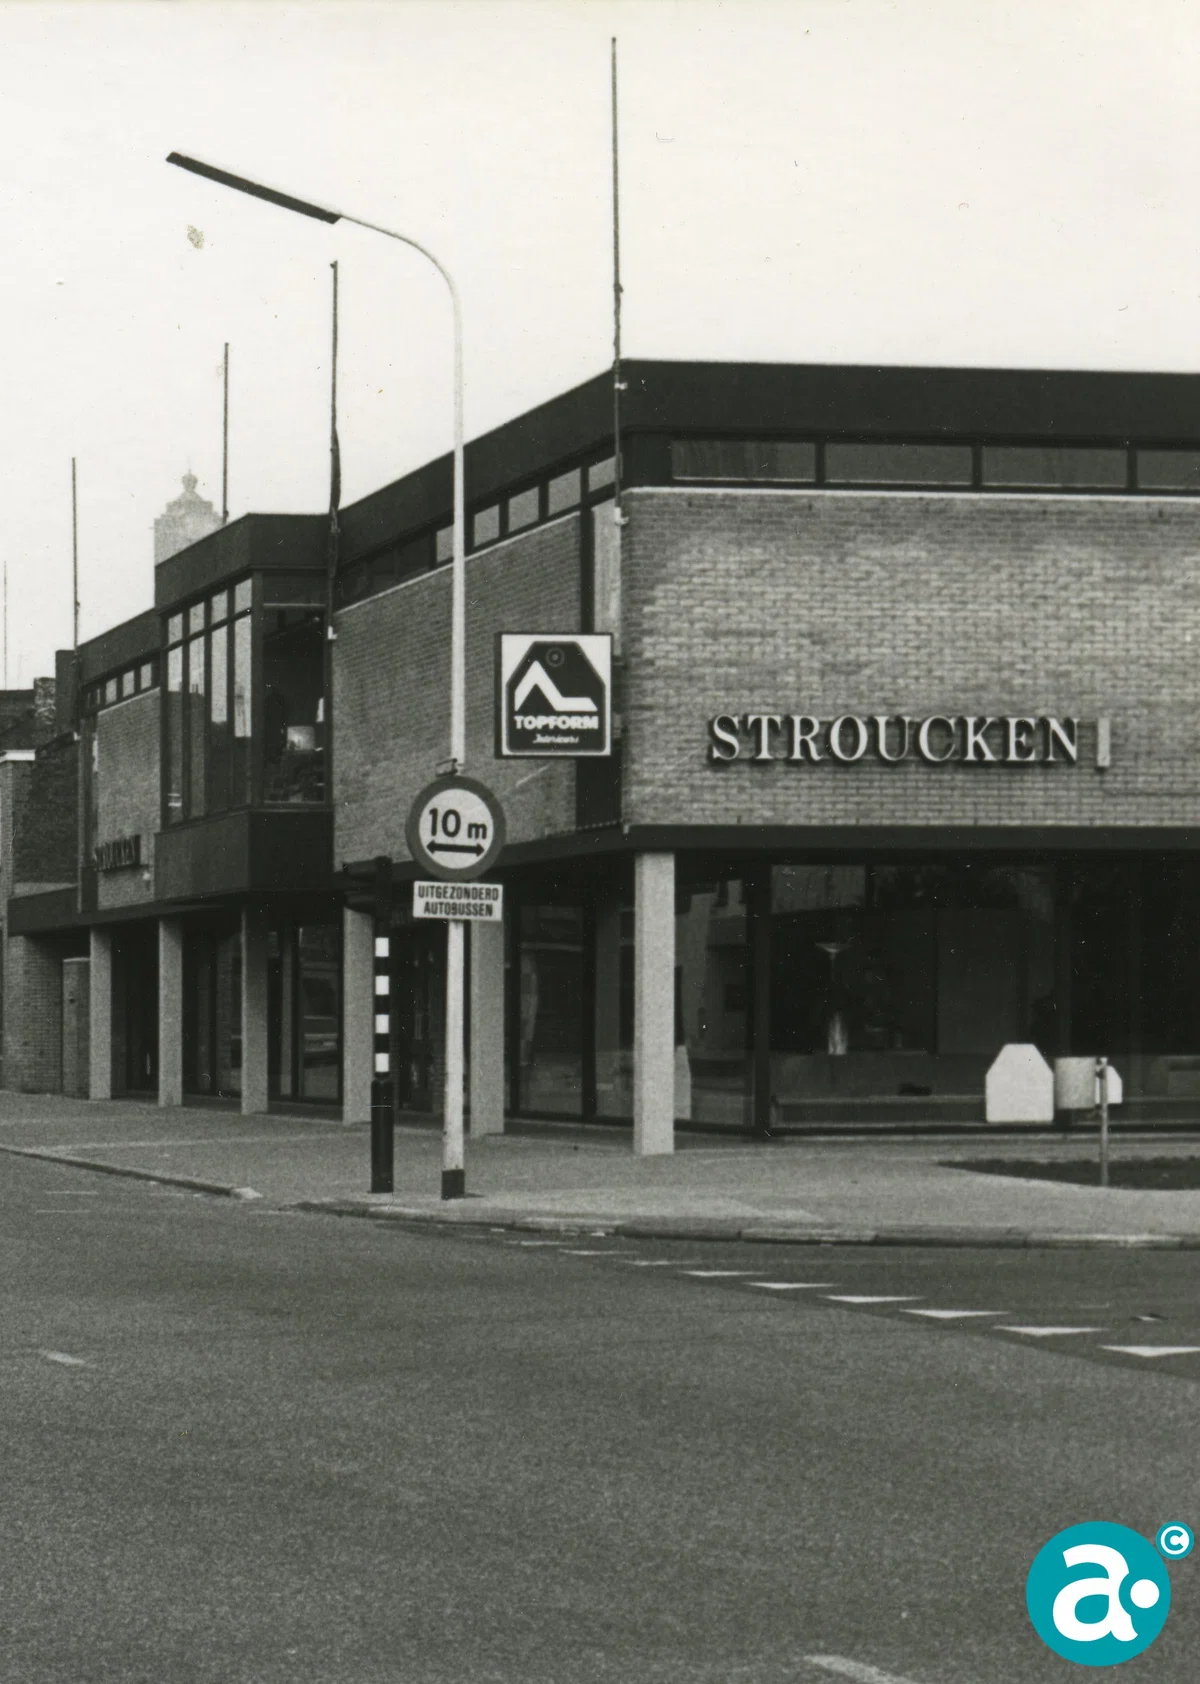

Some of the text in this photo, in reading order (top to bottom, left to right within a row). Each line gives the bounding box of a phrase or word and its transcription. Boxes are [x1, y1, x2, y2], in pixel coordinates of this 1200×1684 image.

[514, 715, 599, 730] TOPFORM
[710, 715, 1081, 761] STROUCKEN
[429, 807, 488, 839] 10 m
[418, 885, 499, 901] UITGEZONDERD
[423, 901, 494, 917] AUTOBUSSEN
